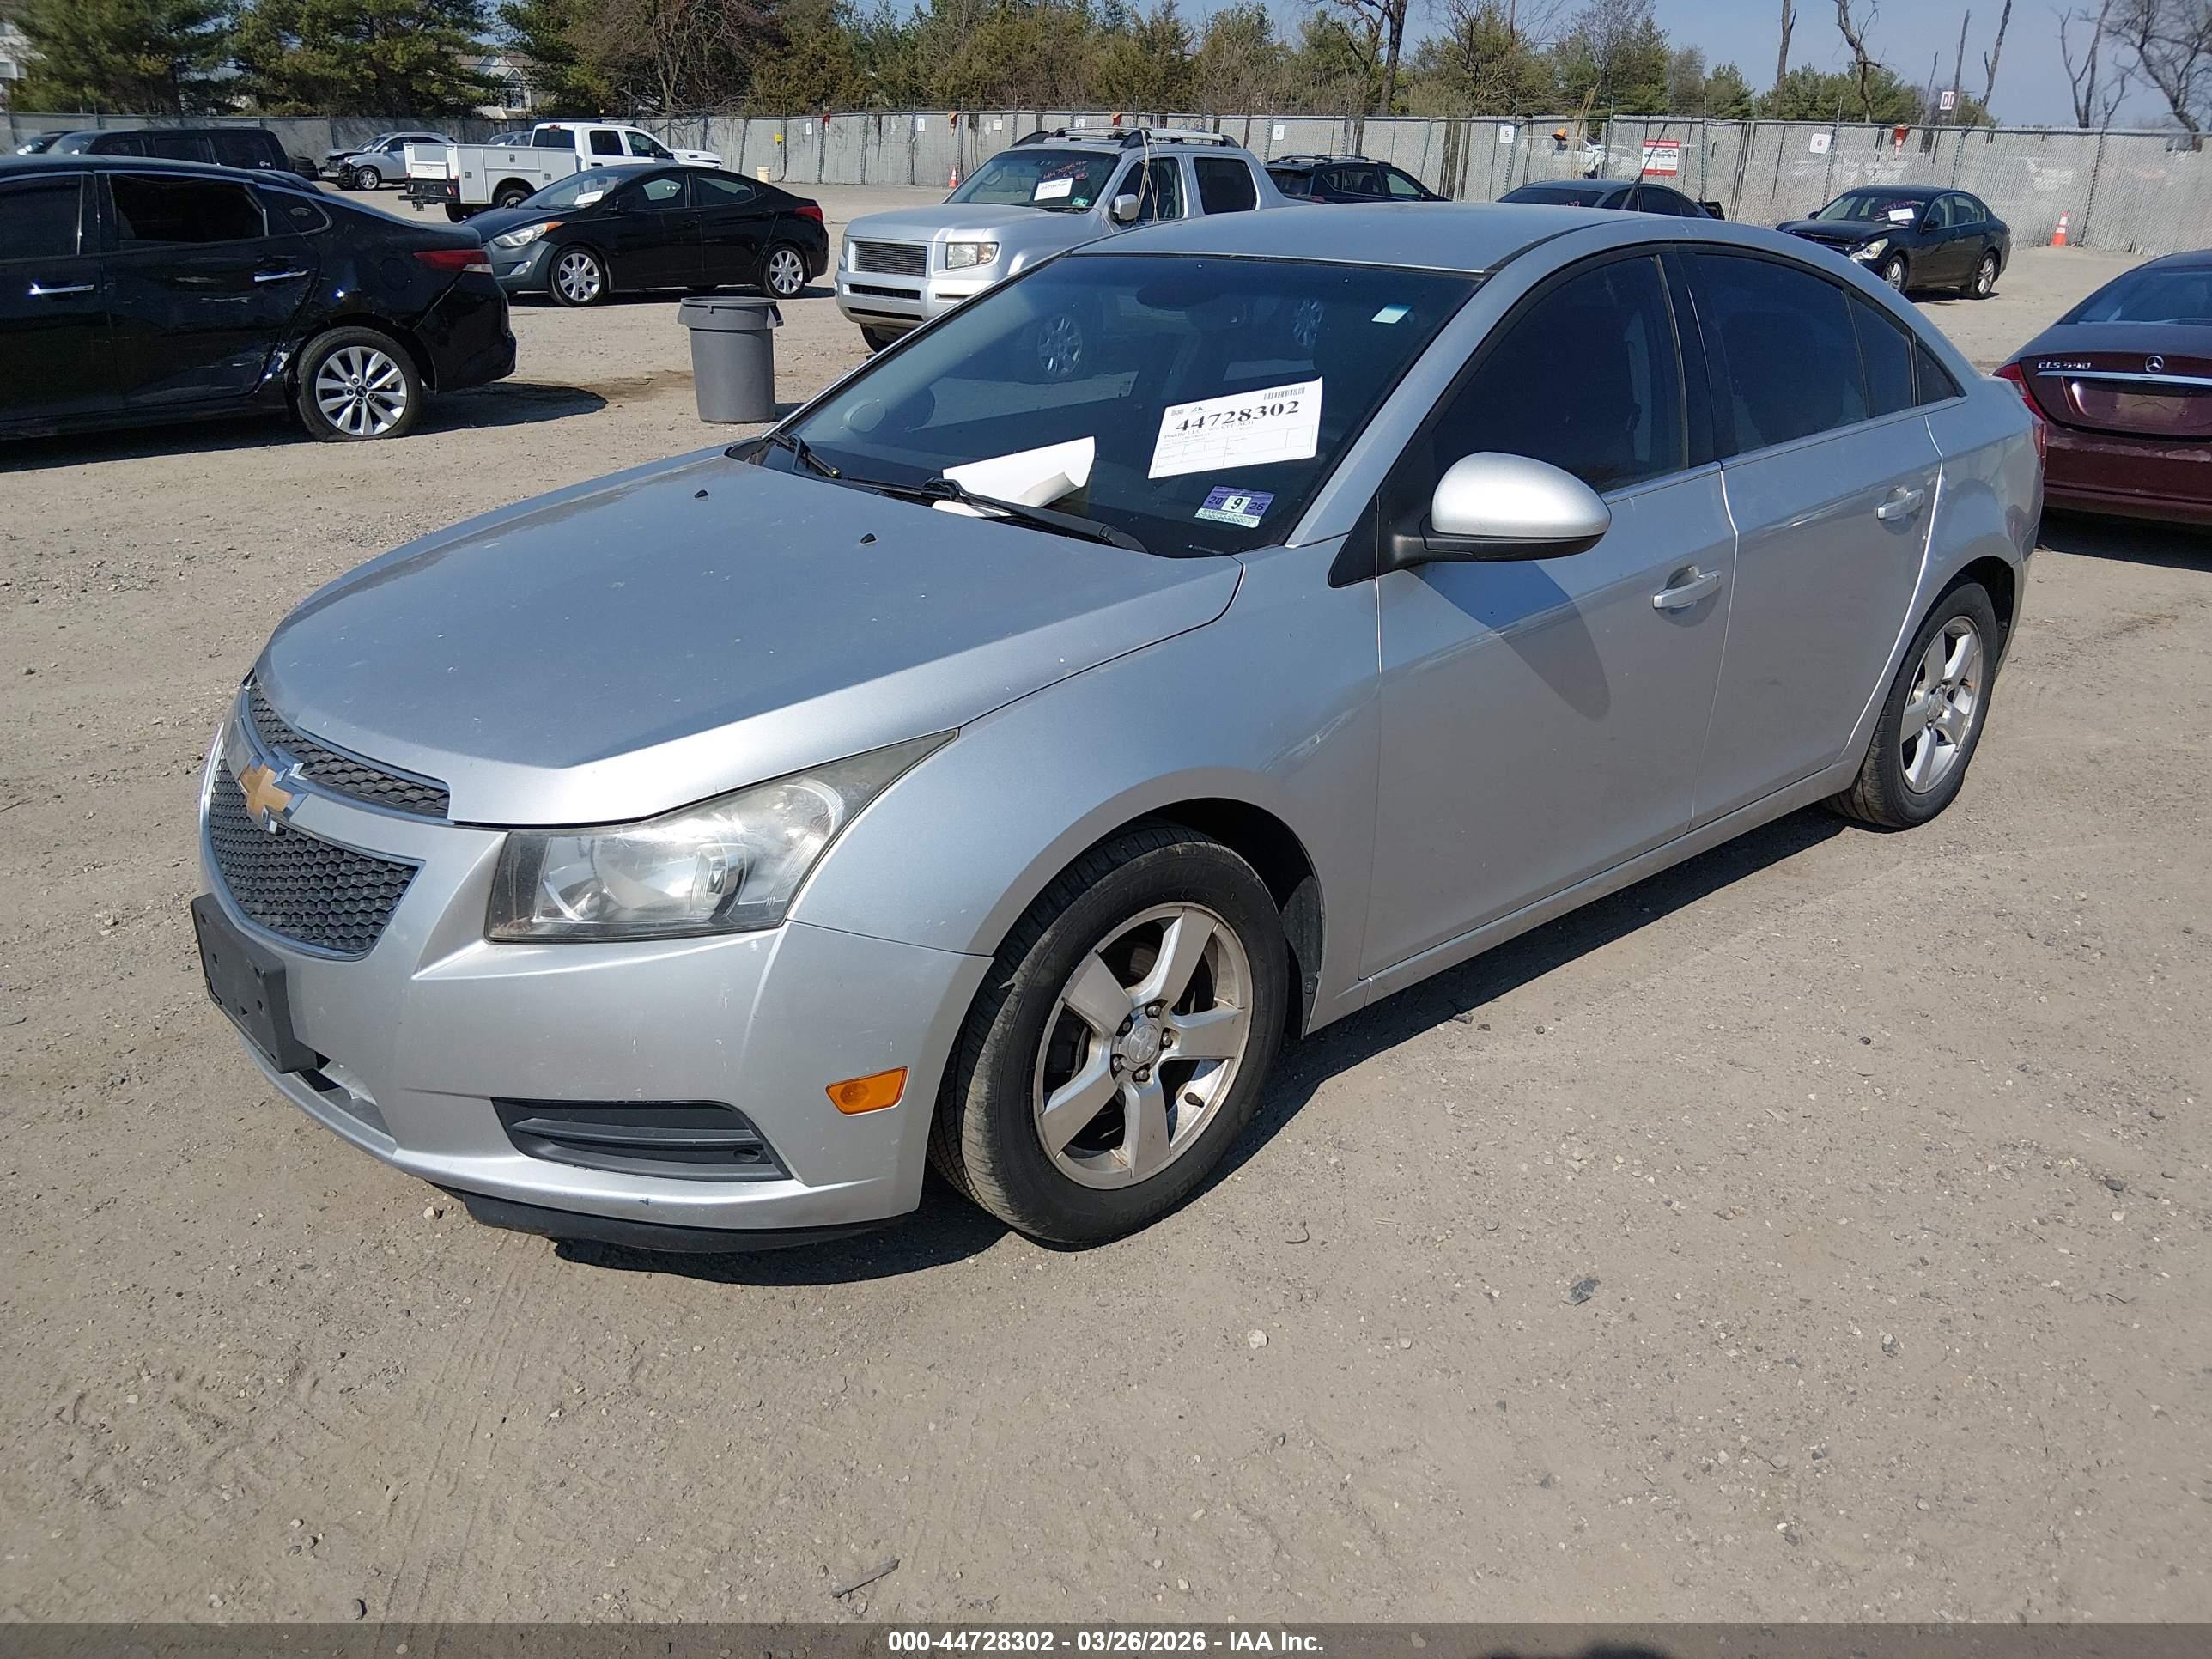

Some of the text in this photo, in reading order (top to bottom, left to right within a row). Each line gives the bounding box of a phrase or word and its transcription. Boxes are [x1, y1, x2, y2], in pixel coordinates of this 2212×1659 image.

[1176, 400, 1299, 431] 44728302
[1208, 496, 1264, 511] 20 9 26
